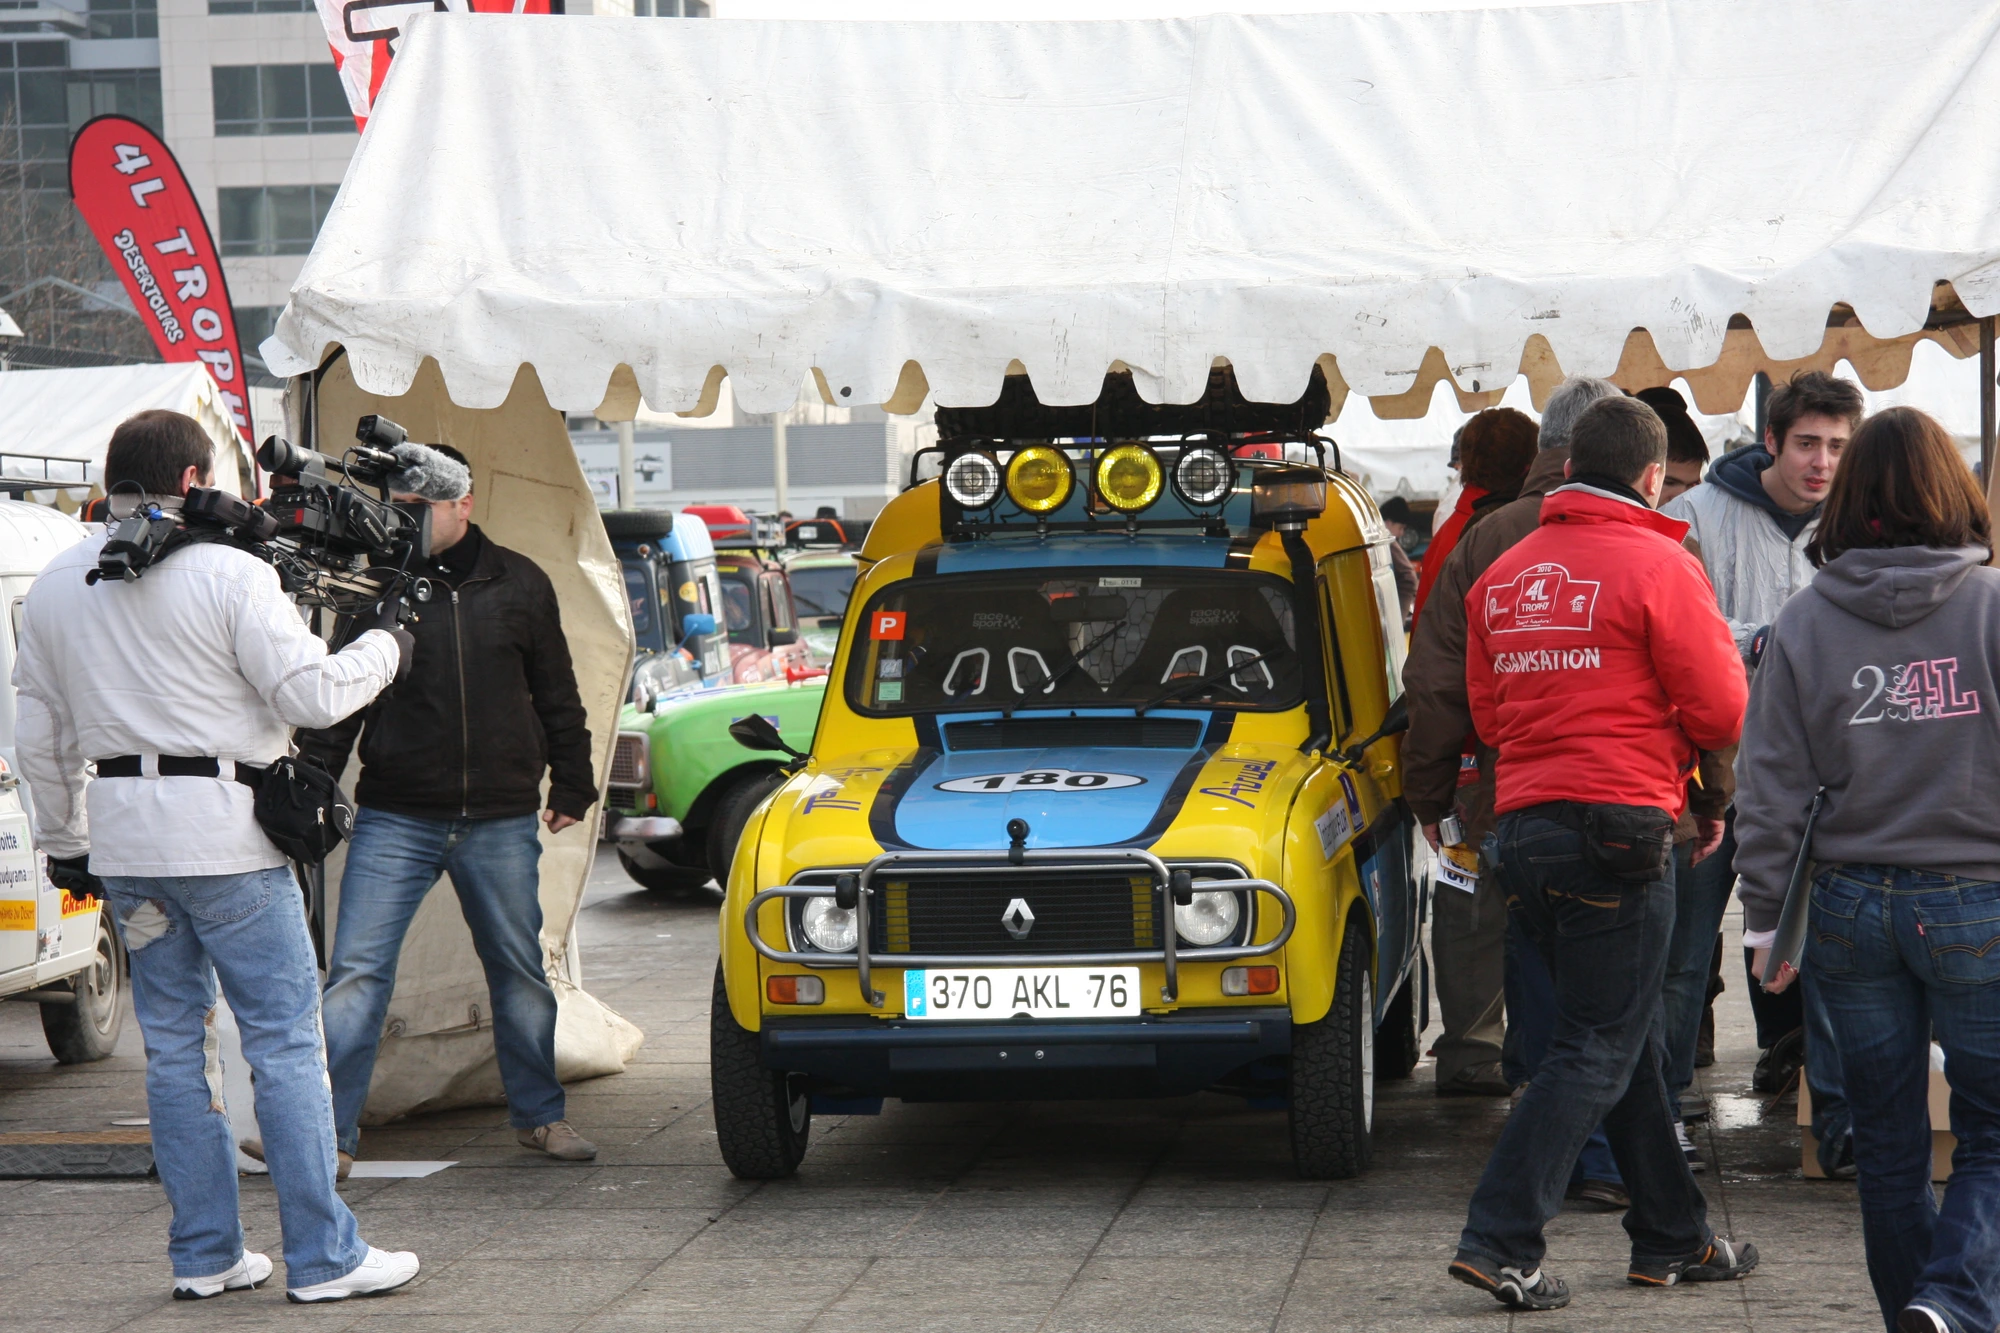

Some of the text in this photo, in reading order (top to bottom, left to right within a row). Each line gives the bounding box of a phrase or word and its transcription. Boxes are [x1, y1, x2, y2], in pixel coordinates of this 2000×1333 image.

[112, 143, 250, 428] 4L TROPH
[113, 228, 185, 345] DESERTOURS
[363, 517, 384, 543] Panasonic
[1536, 565, 1552, 573] 2010
[1524, 578, 1549, 601] 4L
[1190, 608, 1220, 617] race
[1521, 601, 1550, 613] TROPHY
[972, 620, 1004, 630] sport
[973, 612, 1004, 621] race
[1189, 616, 1220, 626] sport
[879, 617, 897, 634] P
[1848, 665, 1886, 725] 2
[1891, 657, 1981, 721] 4L
[972, 772, 1110, 790] 180
[912, 973, 1129, 1010] F 370 AKL 76
